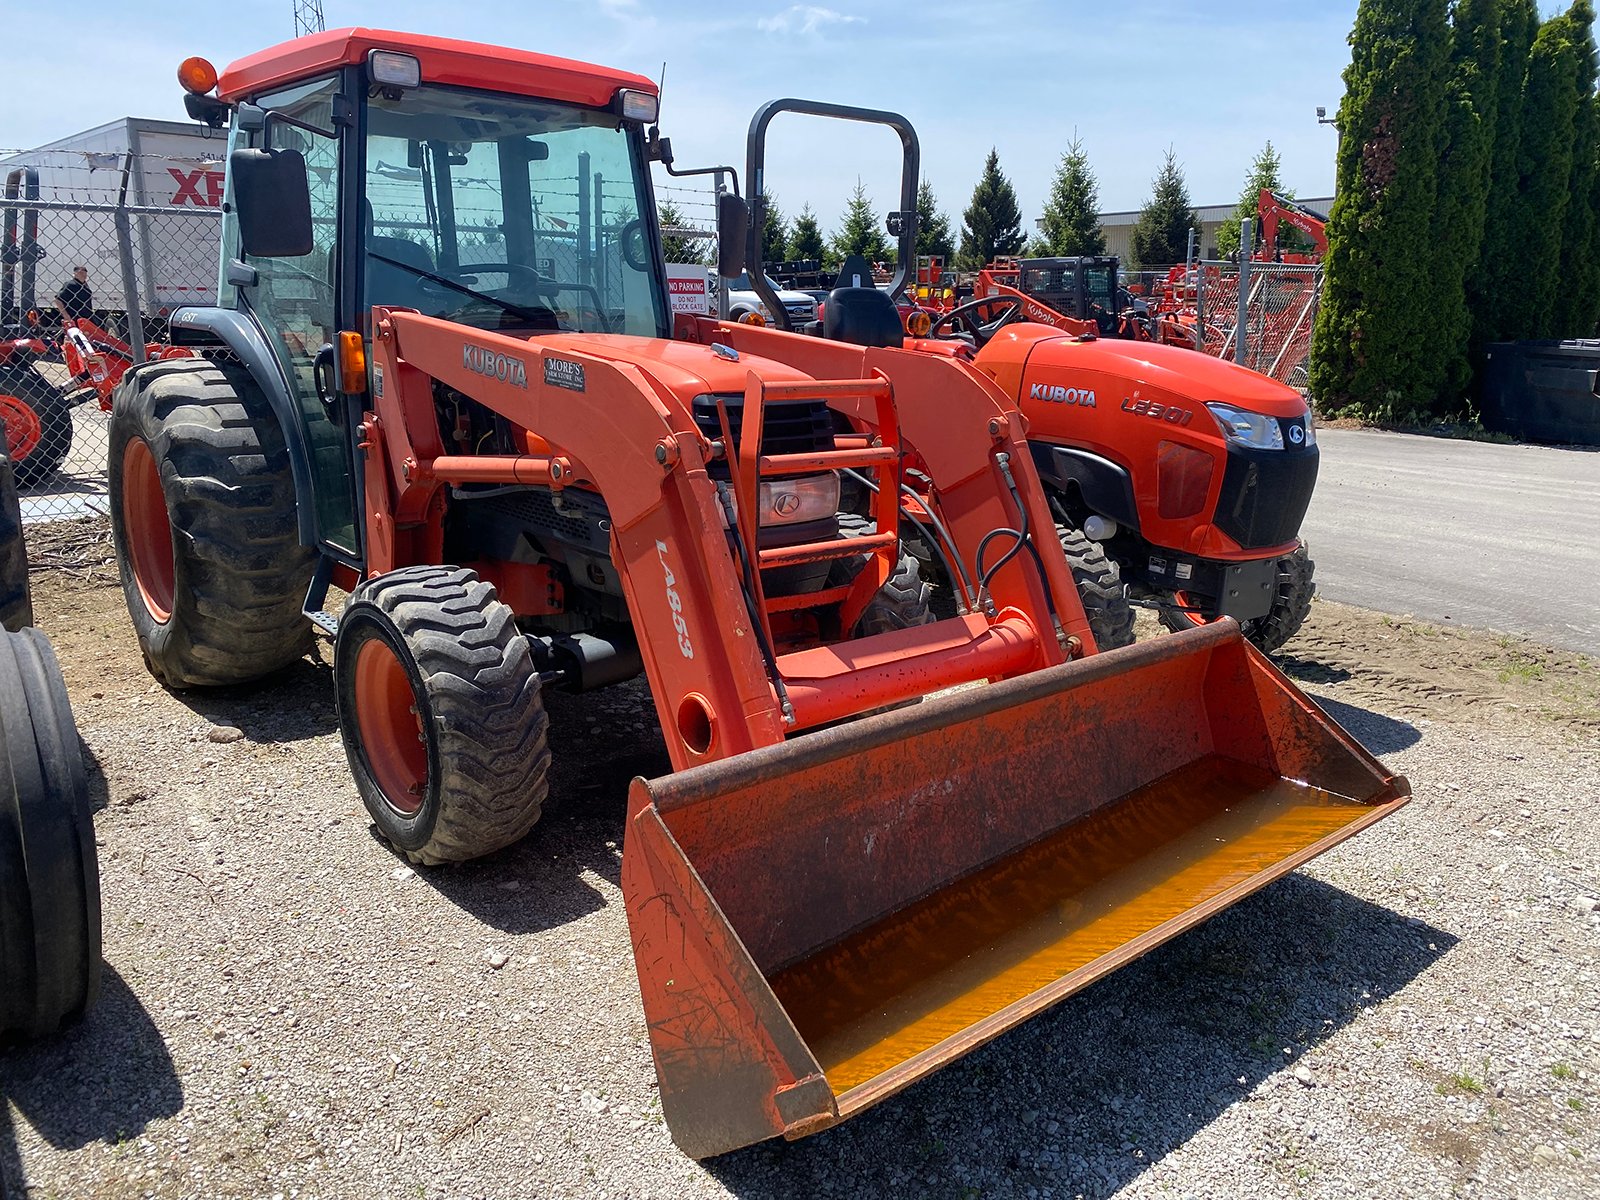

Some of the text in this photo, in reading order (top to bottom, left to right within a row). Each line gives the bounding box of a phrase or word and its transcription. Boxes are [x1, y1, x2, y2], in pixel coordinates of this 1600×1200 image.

[1293, 217, 1312, 233] Kubota
[669, 282, 704, 292] NO PARKING
[181, 312, 198, 322] GST
[1027, 302, 1056, 326] Kubota
[463, 343, 528, 389] KUBOTA
[548, 358, 581, 375] MORE'S
[1030, 383, 1097, 408] KUBOTA
[1121, 397, 1193, 427] L3301
[655, 539, 694, 660] LA853
